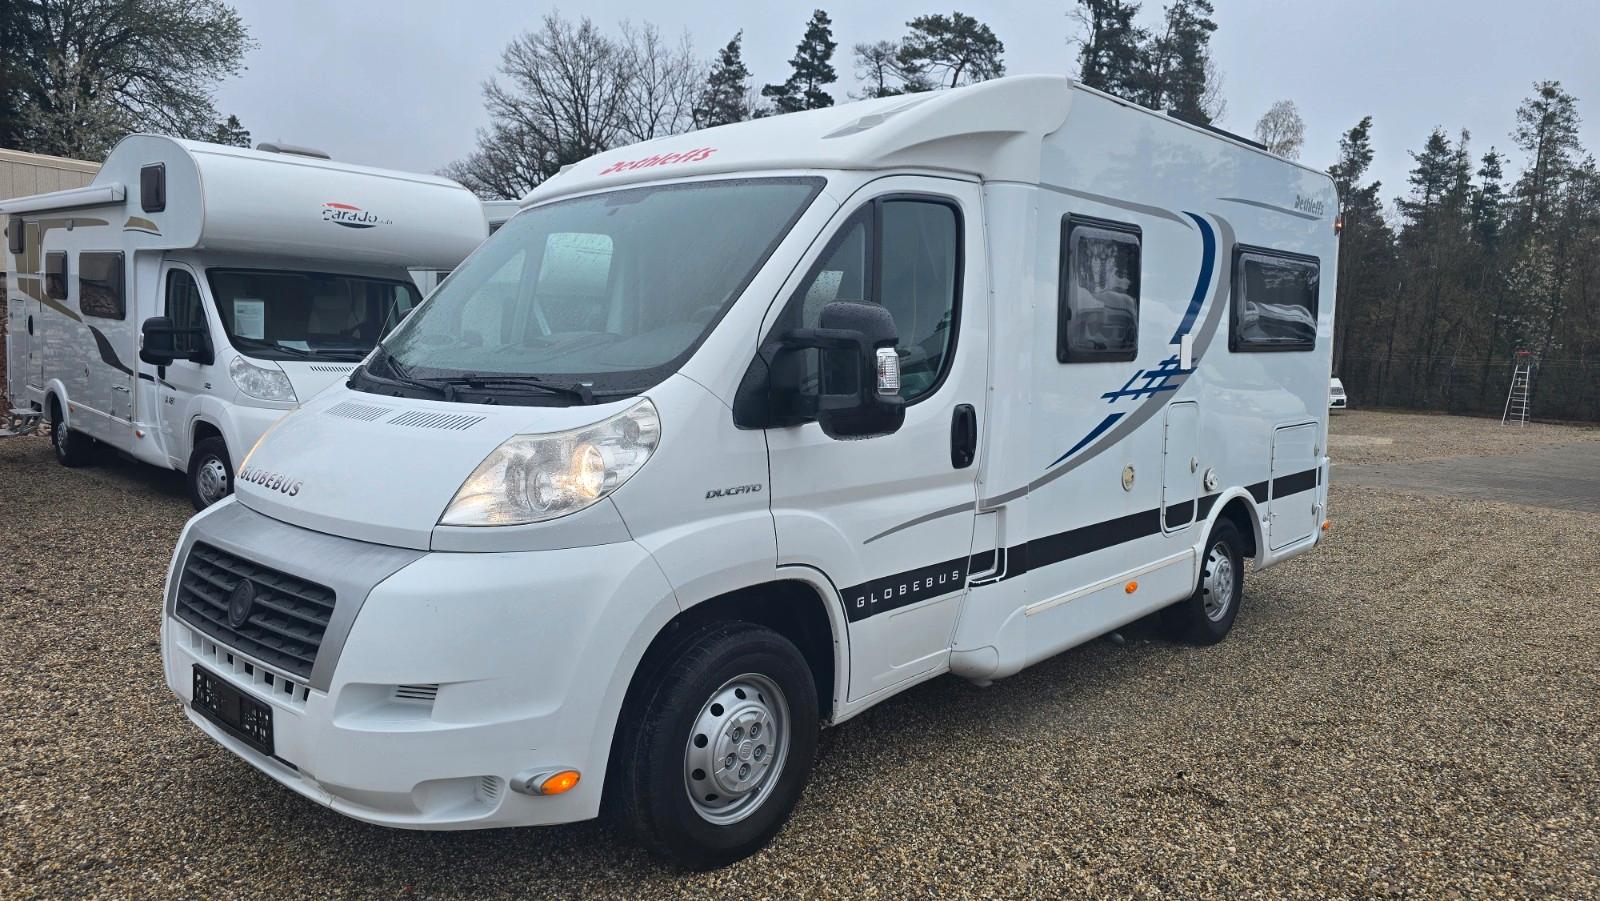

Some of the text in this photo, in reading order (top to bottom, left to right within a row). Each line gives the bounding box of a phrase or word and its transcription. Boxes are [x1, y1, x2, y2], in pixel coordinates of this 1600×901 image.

[240, 467, 304, 497] GLOBEBUS
[705, 484, 762, 499] DUCATO
[856, 570, 959, 608] GLOBEBUS
